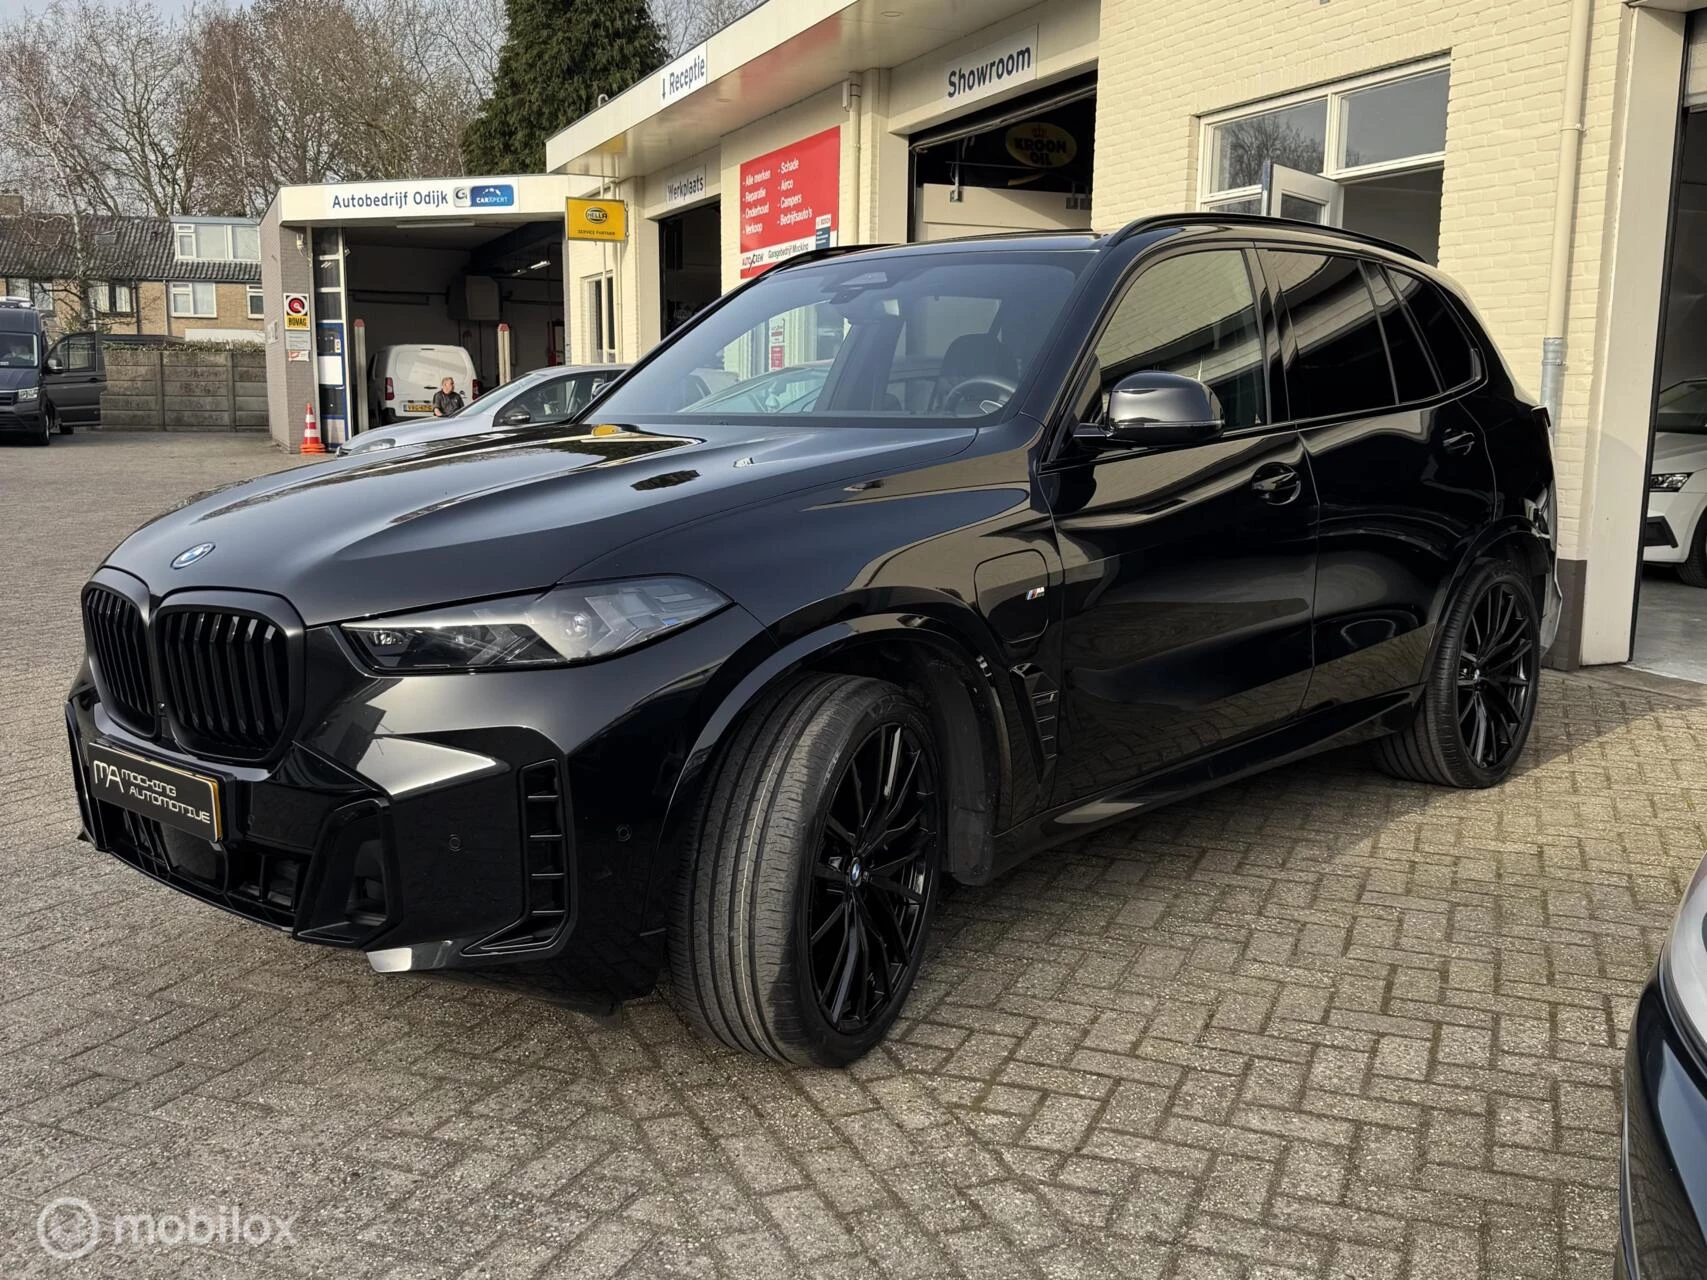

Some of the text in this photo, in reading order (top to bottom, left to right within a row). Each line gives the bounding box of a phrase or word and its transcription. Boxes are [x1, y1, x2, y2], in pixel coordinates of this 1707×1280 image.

[670, 55, 705, 95] Receptie
[947, 46, 1031, 98] Showroom
[1013, 137, 1067, 153] KROON
[781, 158, 799, 173] Schade
[1030, 151, 1053, 165] OIL
[745, 170, 771, 185] Alle merken
[667, 174, 704, 202] Werkplaats
[780, 180, 794, 191] Airco
[332, 190, 449, 209] Autobedrijf Odijk
[745, 188, 766, 203] Reparatie
[780, 194, 802, 208] Campers
[745, 201, 769, 219] Onderhoud
[745, 223, 763, 235] Verkoop
[288, 317, 307, 327] BOVAG
